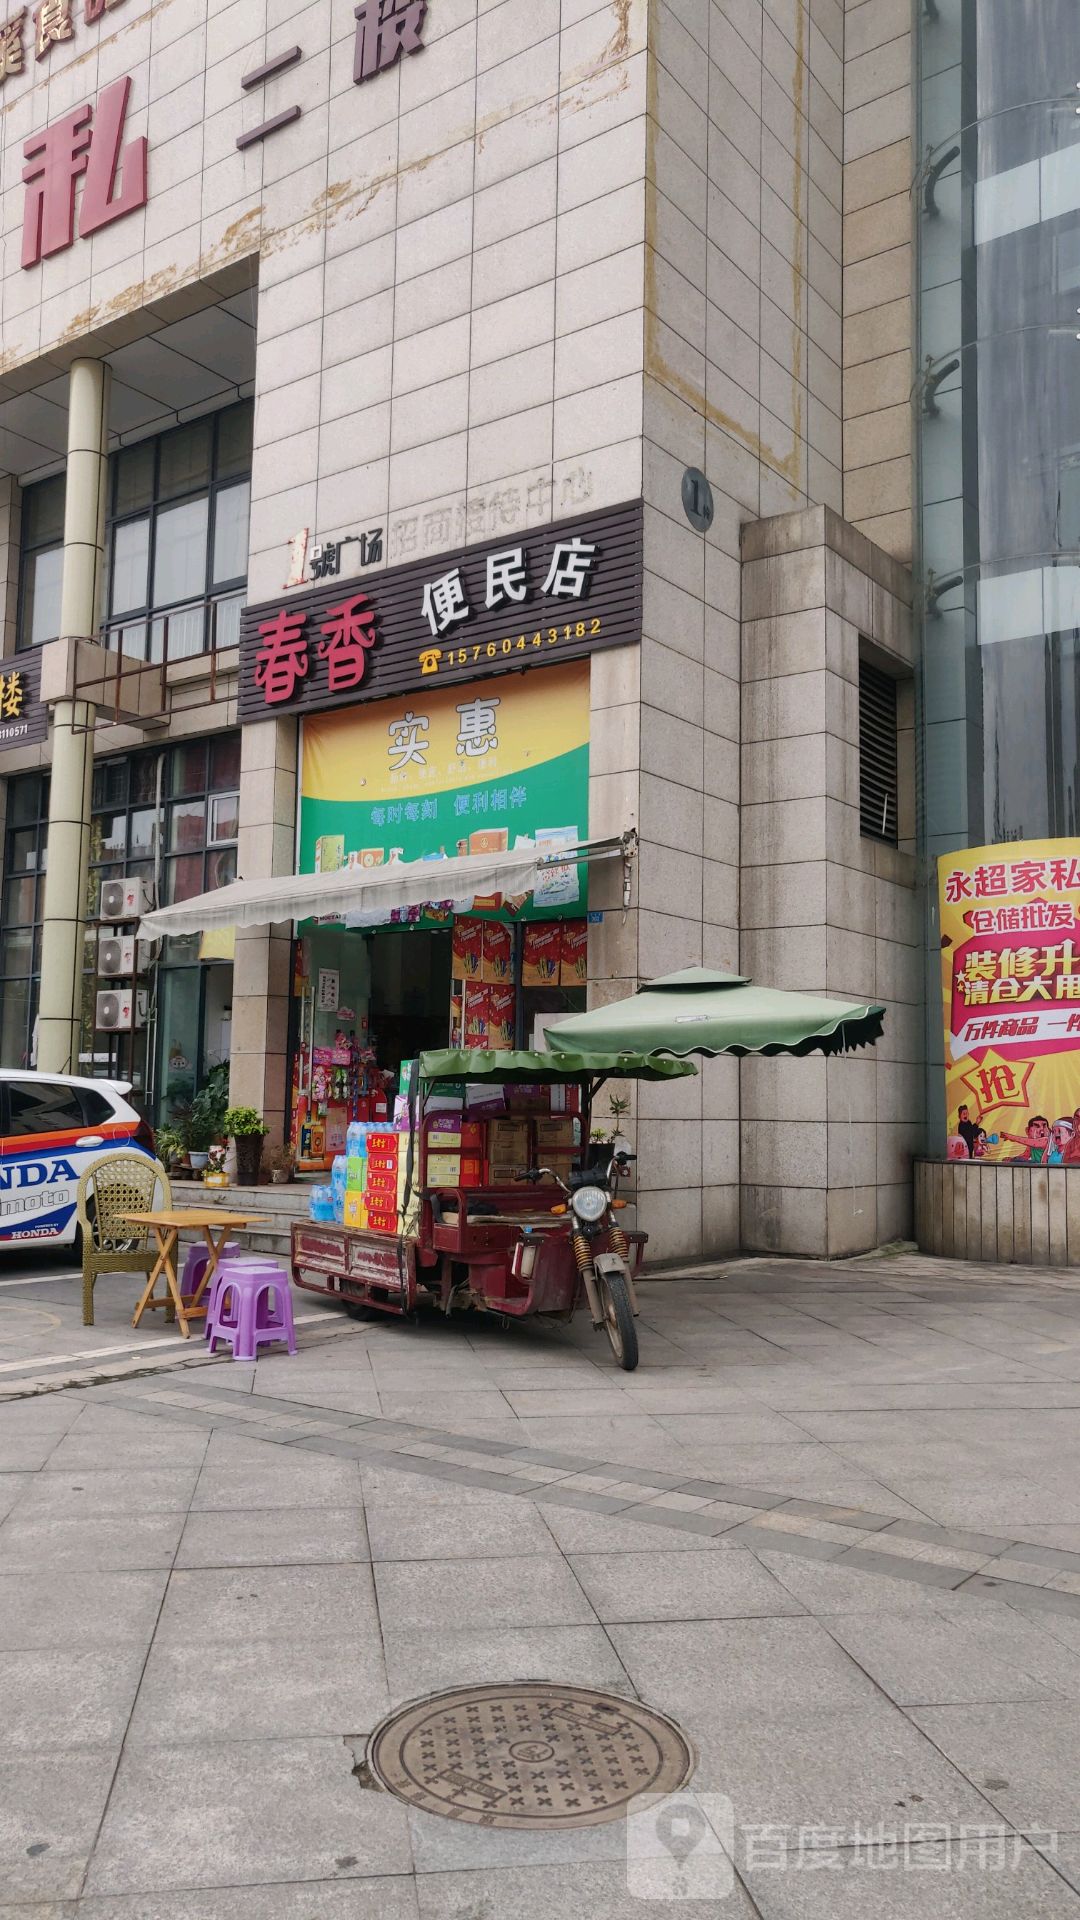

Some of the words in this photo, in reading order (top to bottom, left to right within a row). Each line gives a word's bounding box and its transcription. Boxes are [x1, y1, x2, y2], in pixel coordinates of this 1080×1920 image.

[21, 76, 148, 269] 私
[254, 592, 376, 704] 春香
[421, 538, 596, 636] 便民店
[447, 618, 601, 665] 15760443182
[0, 724, 28, 739] 110571
[387, 697, 501, 771] 实惠
[370, 798, 438, 827] 每时每刻
[454, 786, 527, 816] 便利相伴
[946, 858, 1080, 903] 永超家私
[973, 904, 1073, 933] 仓储批发
[964, 1017, 1039, 1042] 万件商品
[977, 1065, 1020, 1103] 抢
[11, 1227, 59, 1240] HONDA
